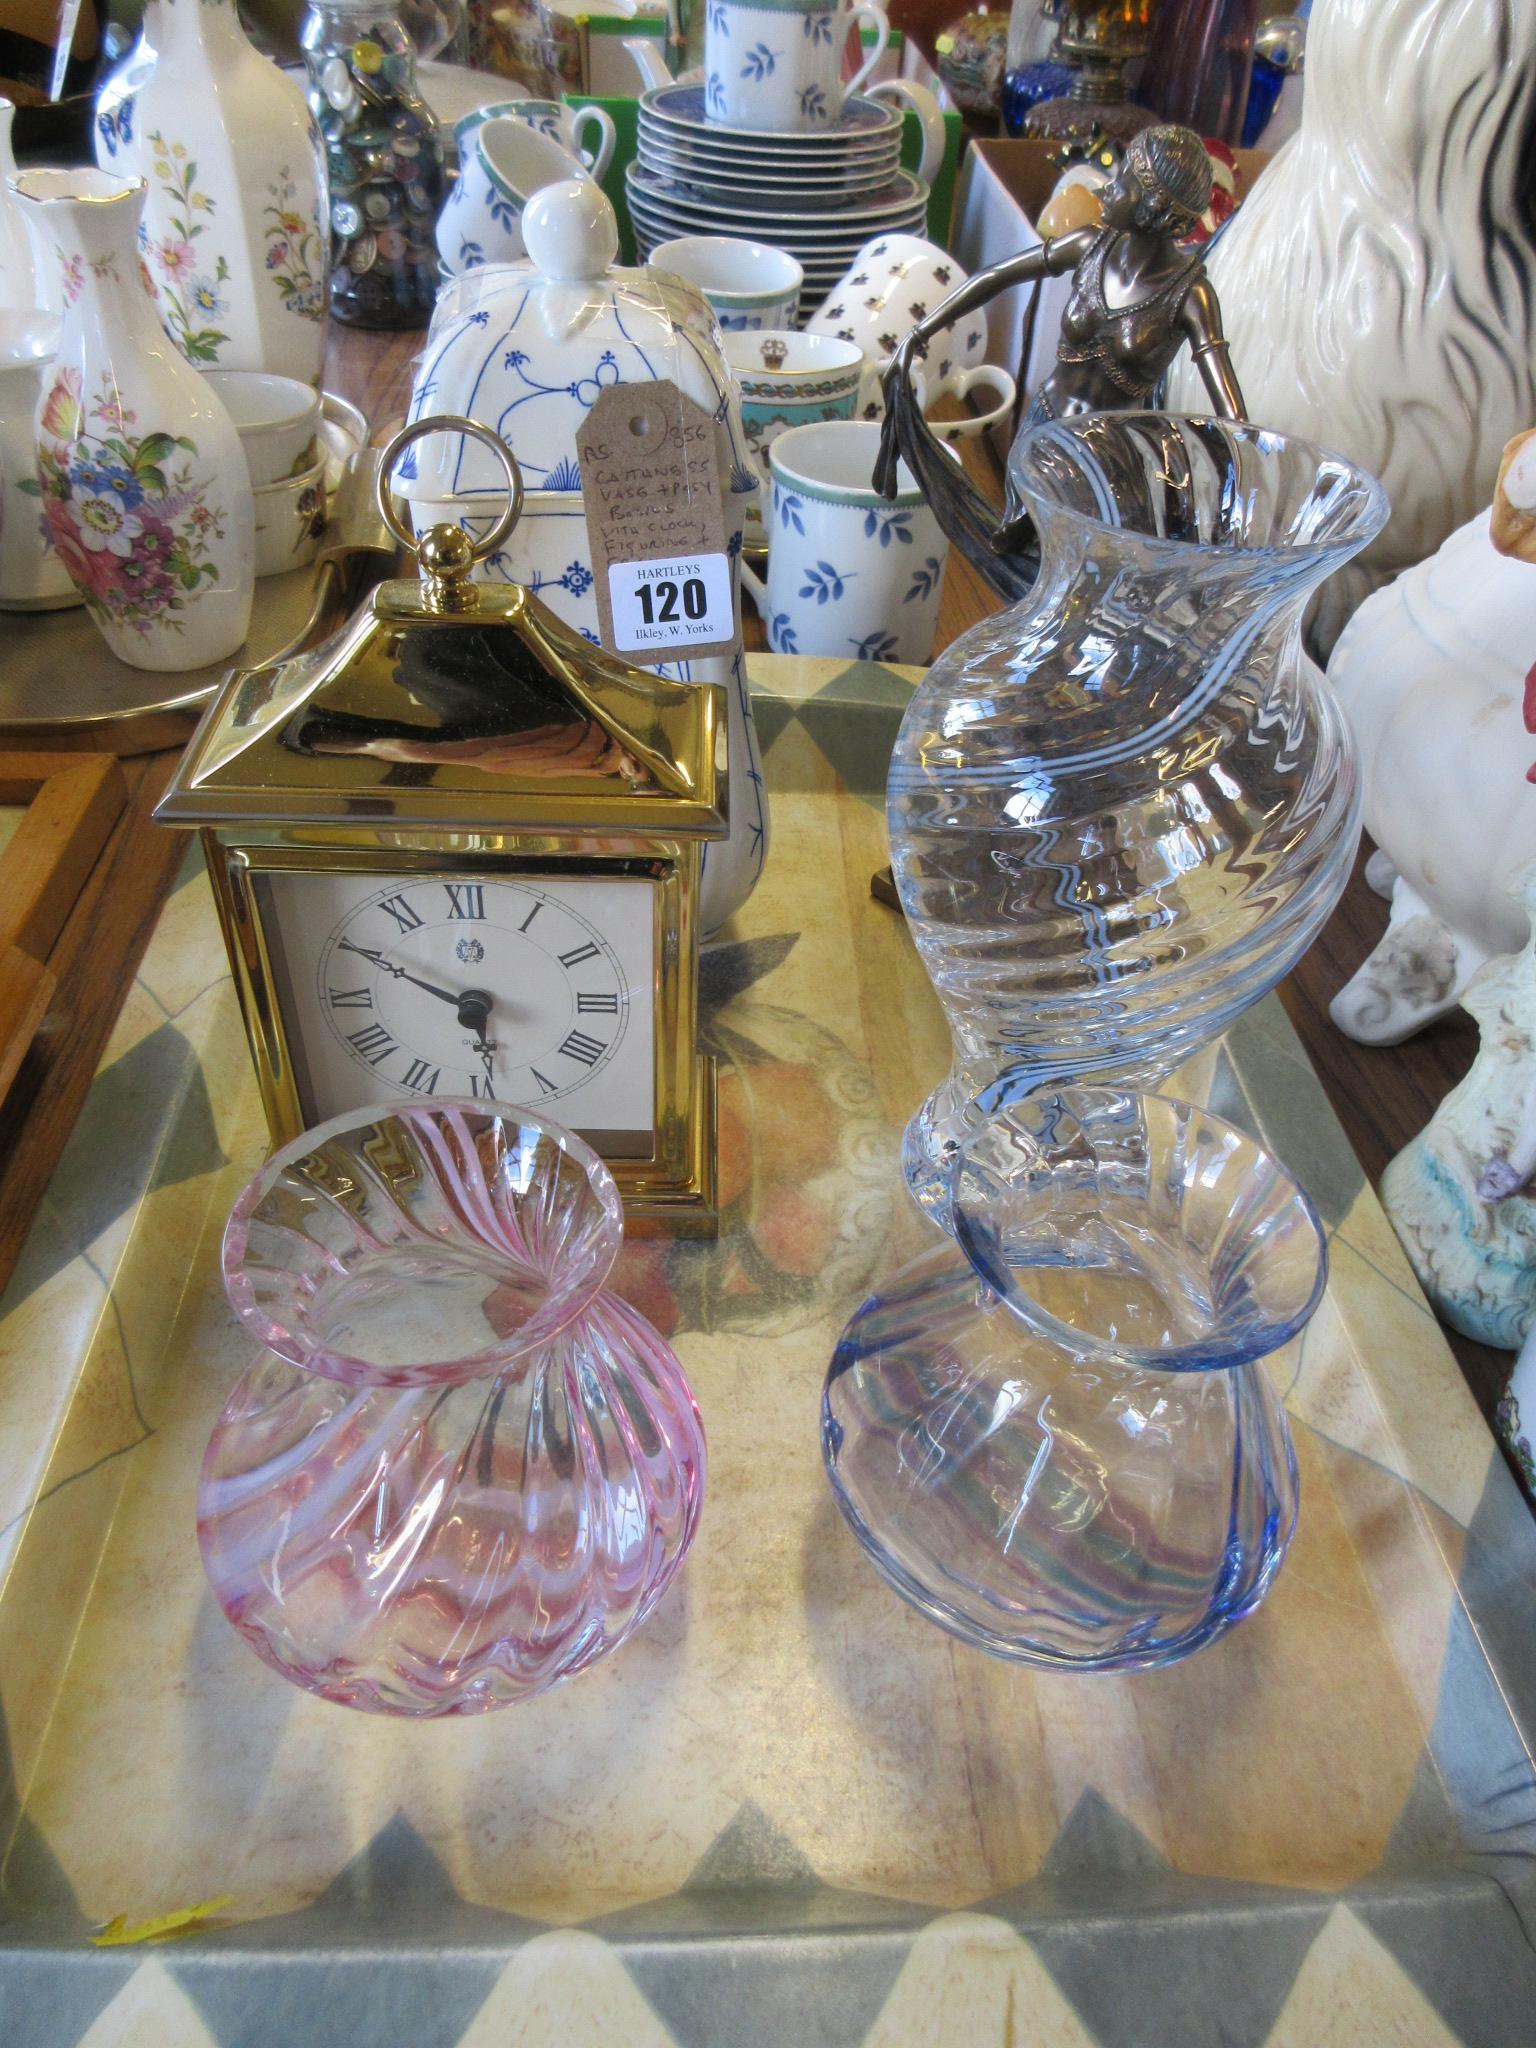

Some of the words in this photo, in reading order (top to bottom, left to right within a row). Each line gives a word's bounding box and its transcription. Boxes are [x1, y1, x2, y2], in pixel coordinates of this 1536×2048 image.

[637, 563, 701, 580] HARTLEYS
[634, 578, 708, 624] 120
[635, 628, 668, 640] Ilkley,
[669, 625, 683, 637] W.
[685, 622, 714, 636] Yorks
[377, 894, 427, 934] XI
[444, 884, 487, 919] XII
[517, 901, 544, 933] I
[557, 941, 602, 969] II
[329, 987, 373, 1009] IX
[577, 992, 618, 1014] III
[346, 1022, 400, 1066] VIII
[558, 1028, 608, 1067] IIII
[400, 1058, 441, 1095] VII
[529, 1066, 559, 1094] V
